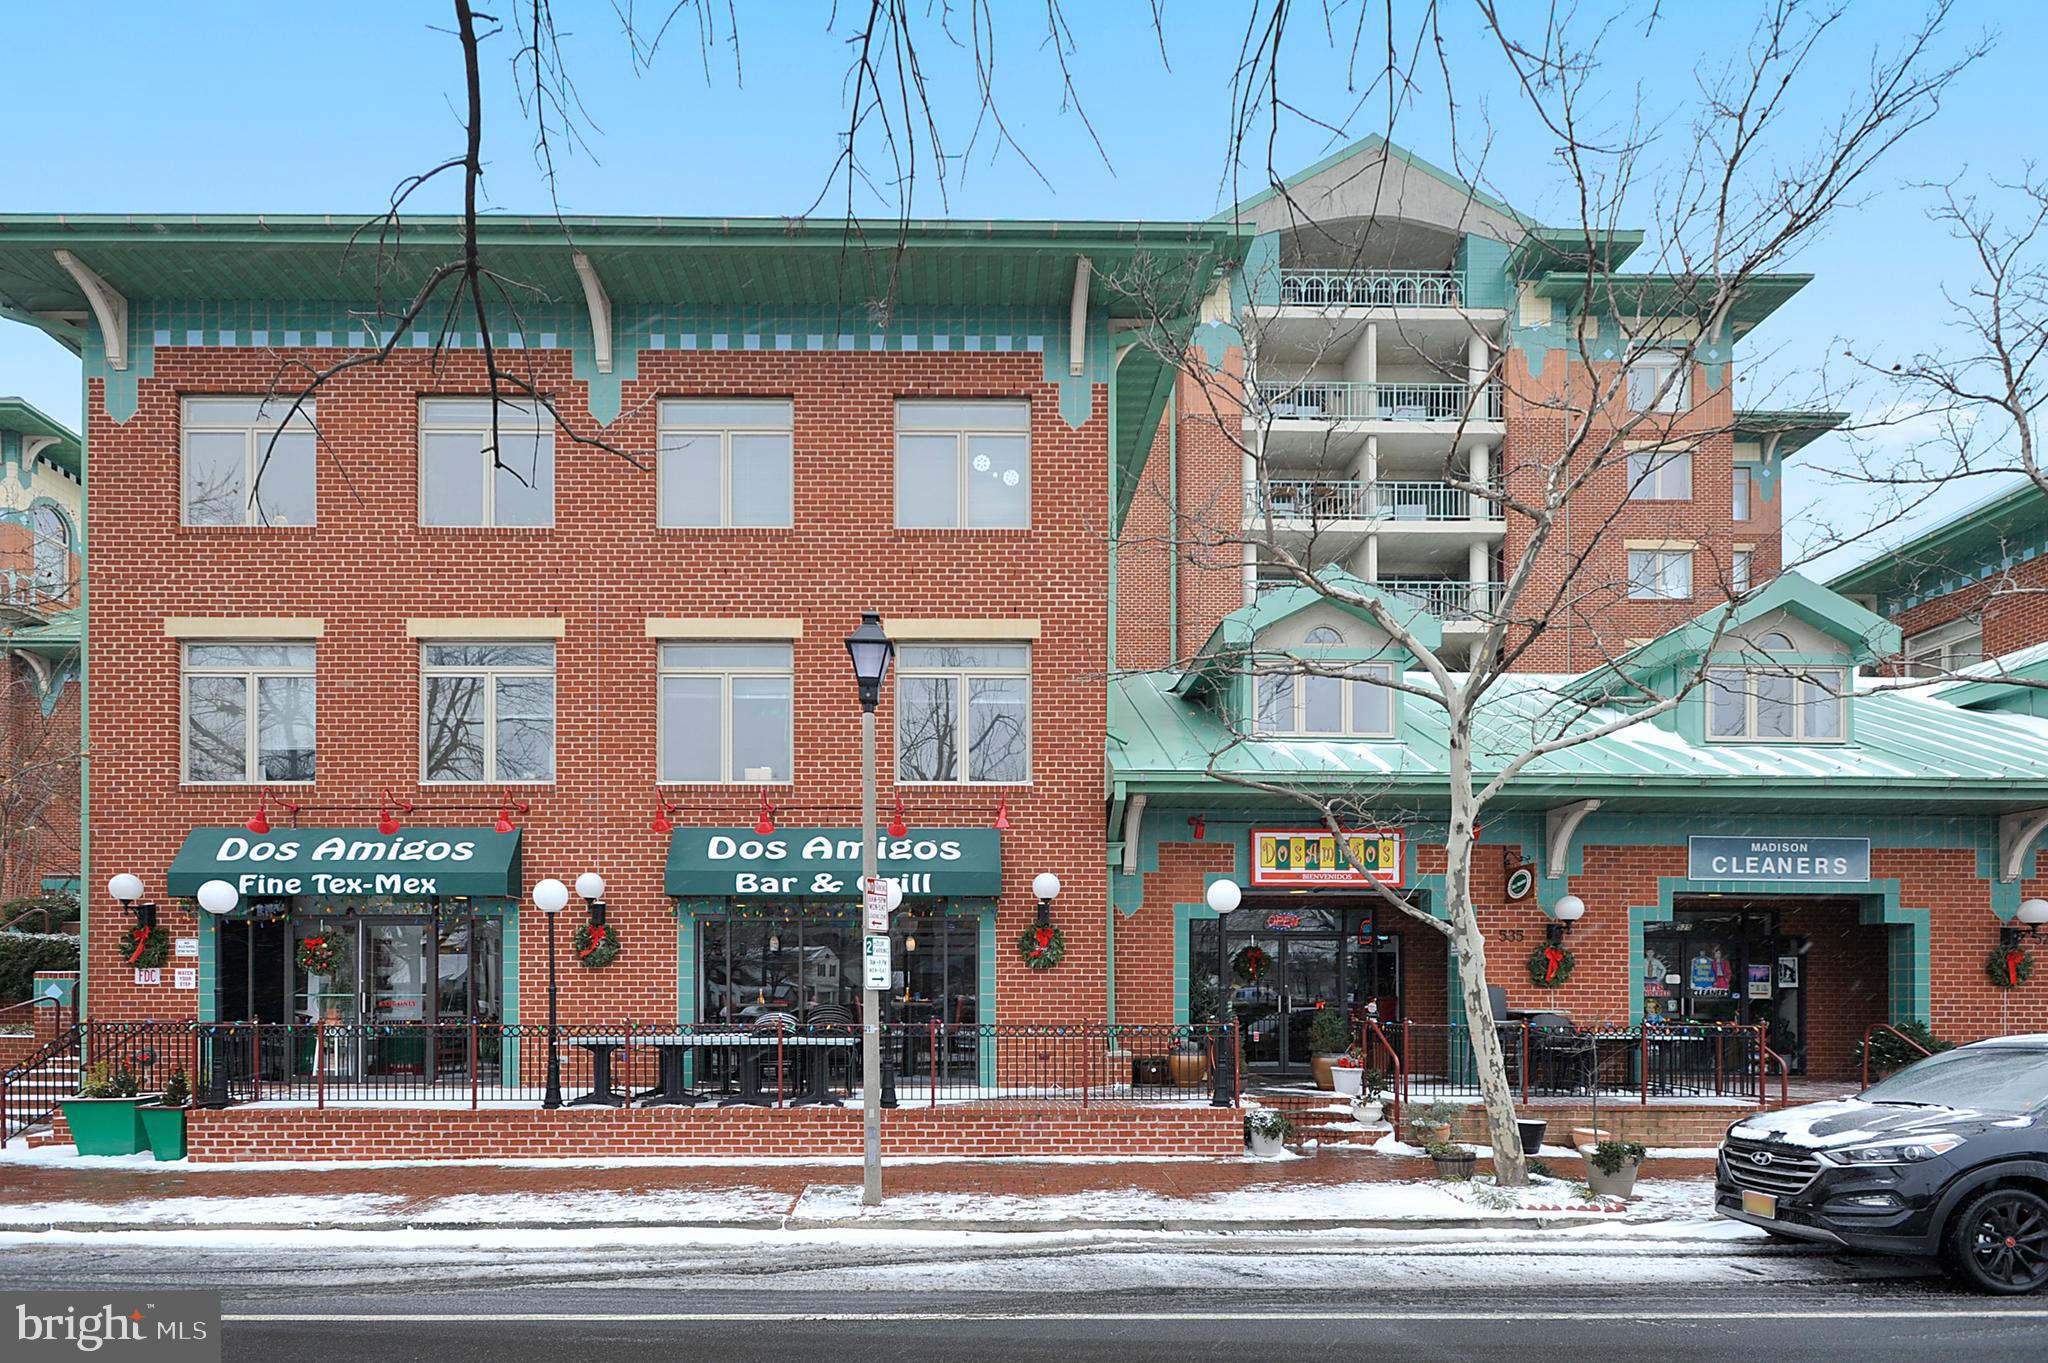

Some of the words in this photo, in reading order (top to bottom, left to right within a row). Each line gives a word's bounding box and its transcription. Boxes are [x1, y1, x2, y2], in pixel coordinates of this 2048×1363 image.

[216, 837, 300, 861] Dos
[311, 836, 475, 861] Amigos
[708, 836, 787, 860] Dos
[802, 836, 961, 860] Amigos
[1751, 842, 1808, 852] MADISON
[1711, 856, 1848, 874] CLEANERS
[239, 874, 301, 894] Fine
[311, 874, 436, 894] Tex-Mex
[735, 873, 798, 893] Bar
[810, 873, 844, 893] &
[857, 873, 931, 893] ill
[1265, 915, 1300, 927] OPEN
[1499, 930, 1524, 942] 535
[866, 940, 872, 954] 2
[138, 969, 156, 983] FDC
